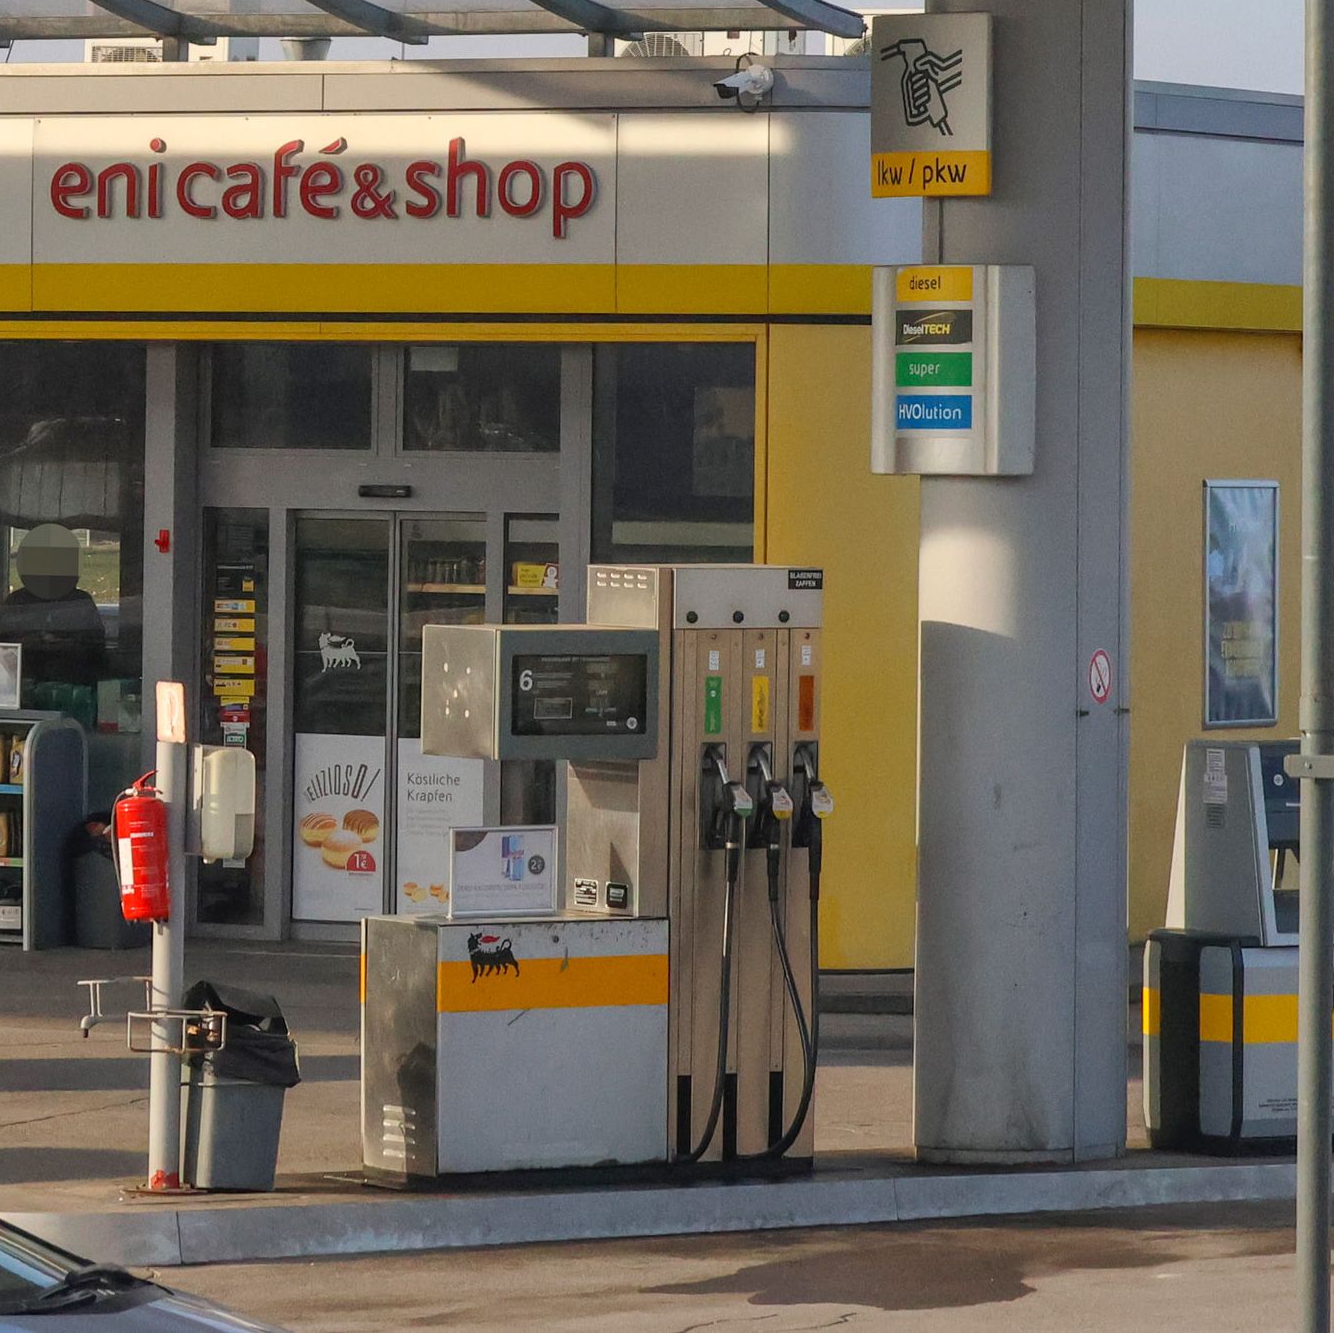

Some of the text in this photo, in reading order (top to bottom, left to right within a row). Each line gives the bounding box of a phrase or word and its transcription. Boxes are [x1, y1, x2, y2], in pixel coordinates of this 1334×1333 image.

[878, 159, 902, 186] lkw
[923, 157, 966, 190] pkw
[909, 275, 941, 290] diesel
[909, 363, 939, 377] super
[899, 403, 962, 420] HVOlution
[519, 669, 534, 692] 6
[407, 771, 460, 787] Köstliche
[407, 789, 453, 804] Krapfen
